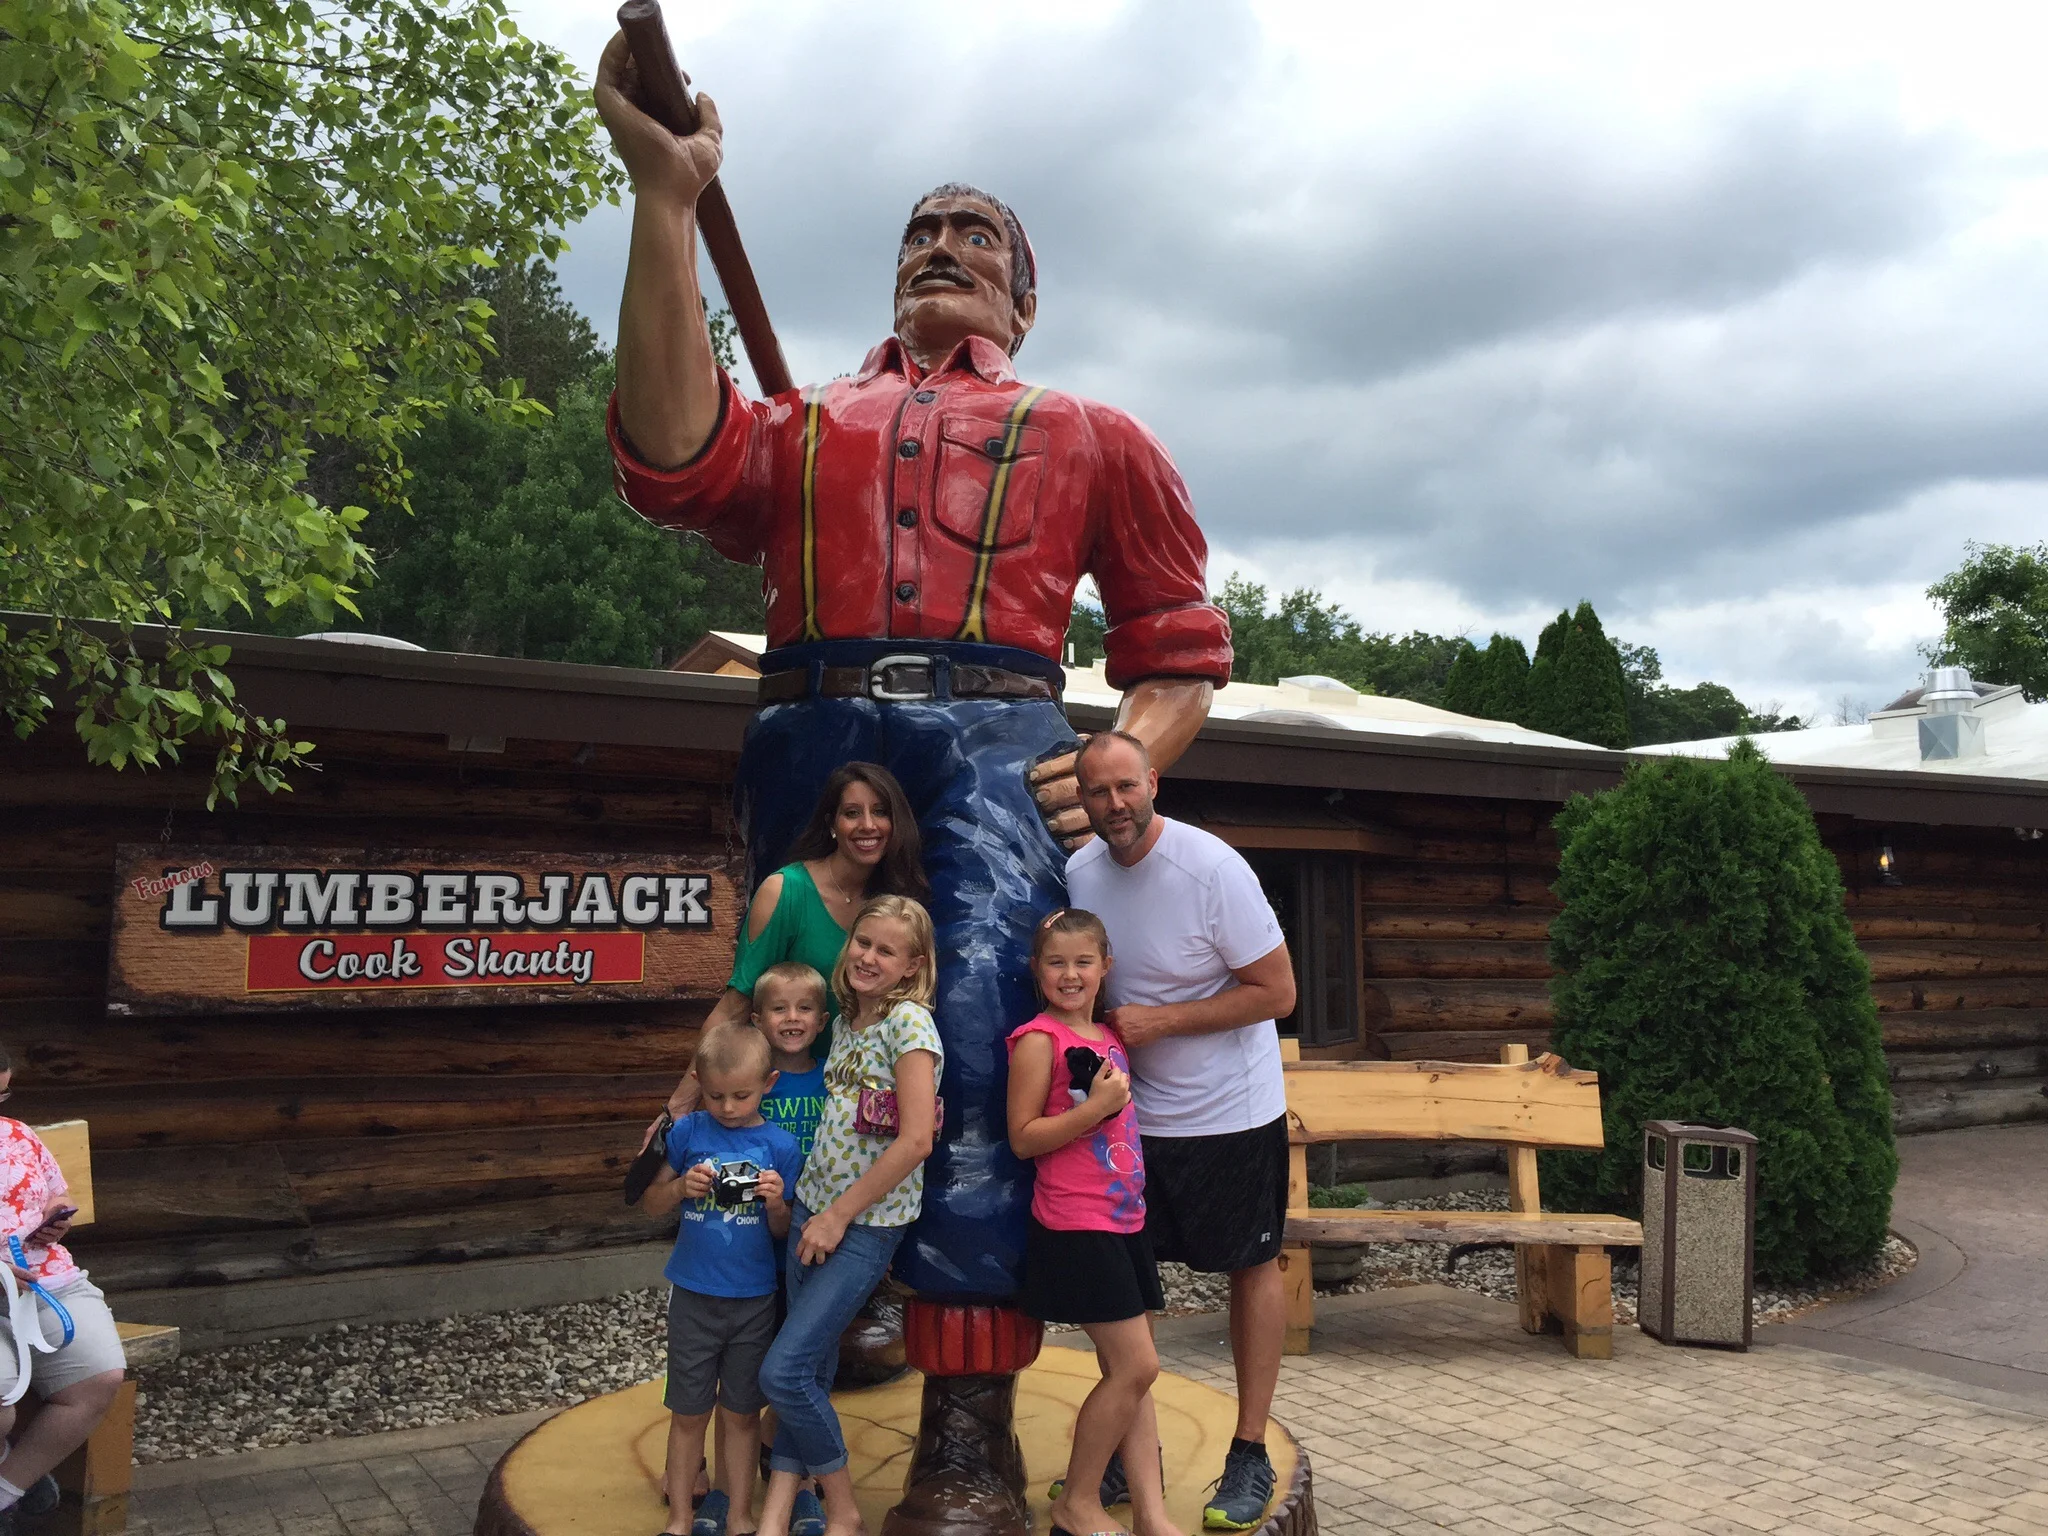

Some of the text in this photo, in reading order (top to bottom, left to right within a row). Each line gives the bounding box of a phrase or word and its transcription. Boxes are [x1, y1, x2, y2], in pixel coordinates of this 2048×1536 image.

[132, 861, 213, 899] Famous
[164, 871, 709, 926] LUMBERJACK
[299, 937, 594, 983] Cook Shanty
